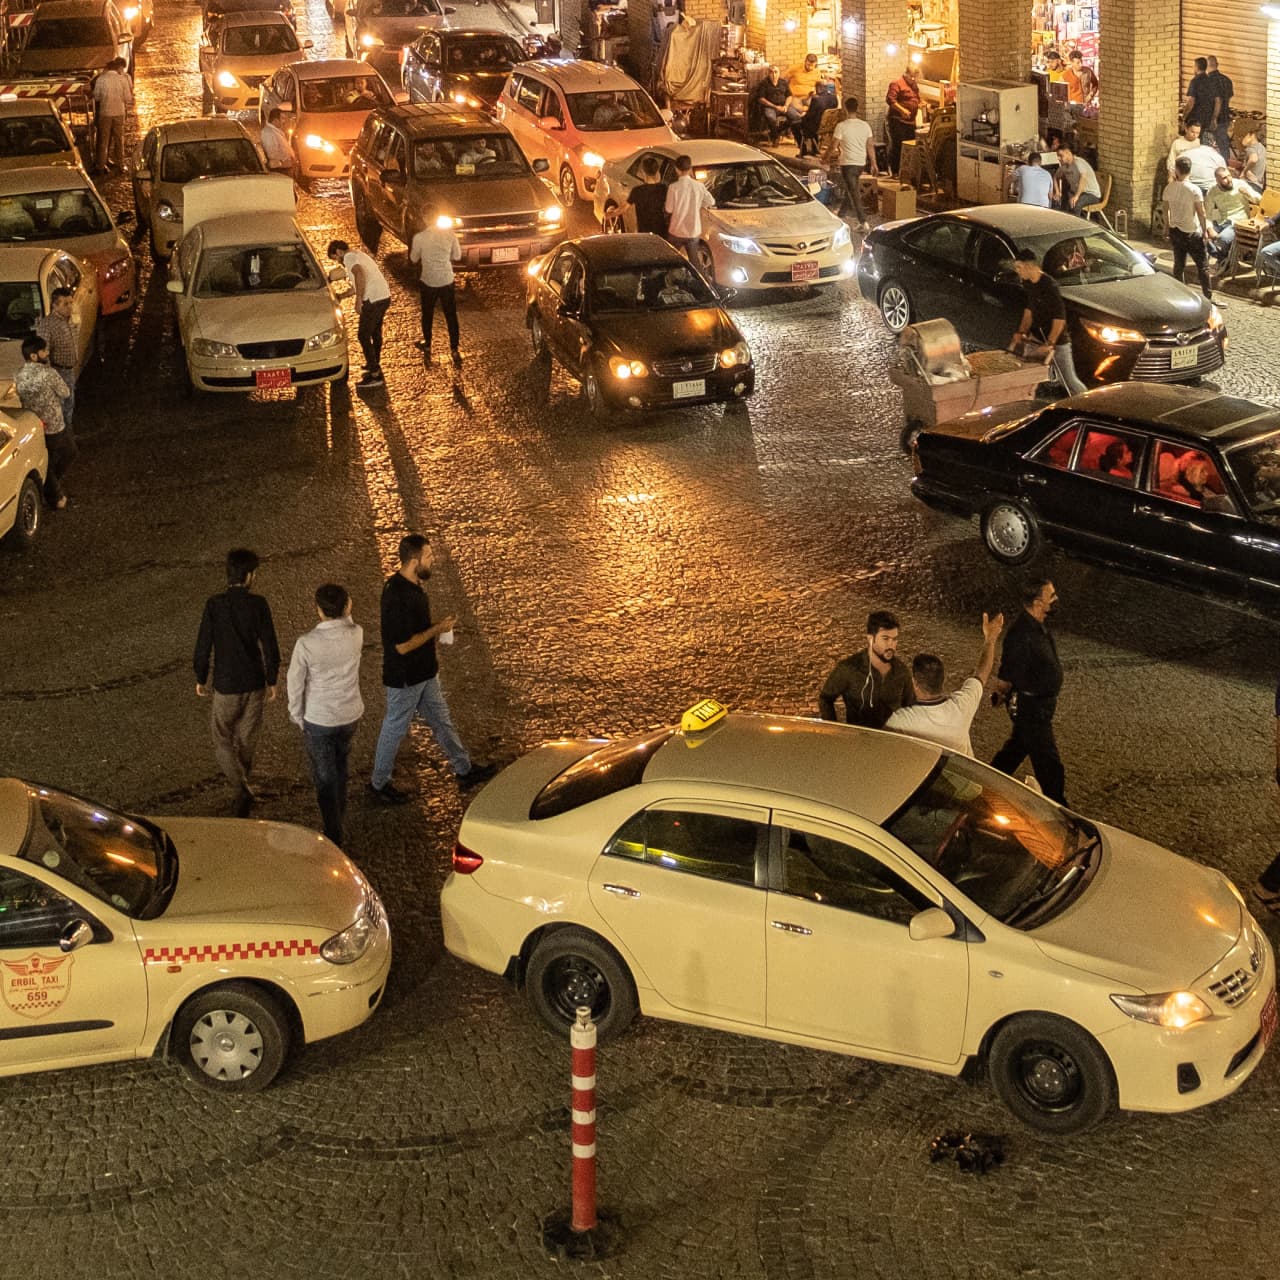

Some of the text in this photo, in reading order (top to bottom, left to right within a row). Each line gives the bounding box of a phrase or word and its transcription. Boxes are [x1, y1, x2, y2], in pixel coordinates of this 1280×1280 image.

[11, 975, 59, 987] ERBIL TAXI
[27, 991, 48, 1001] 659
